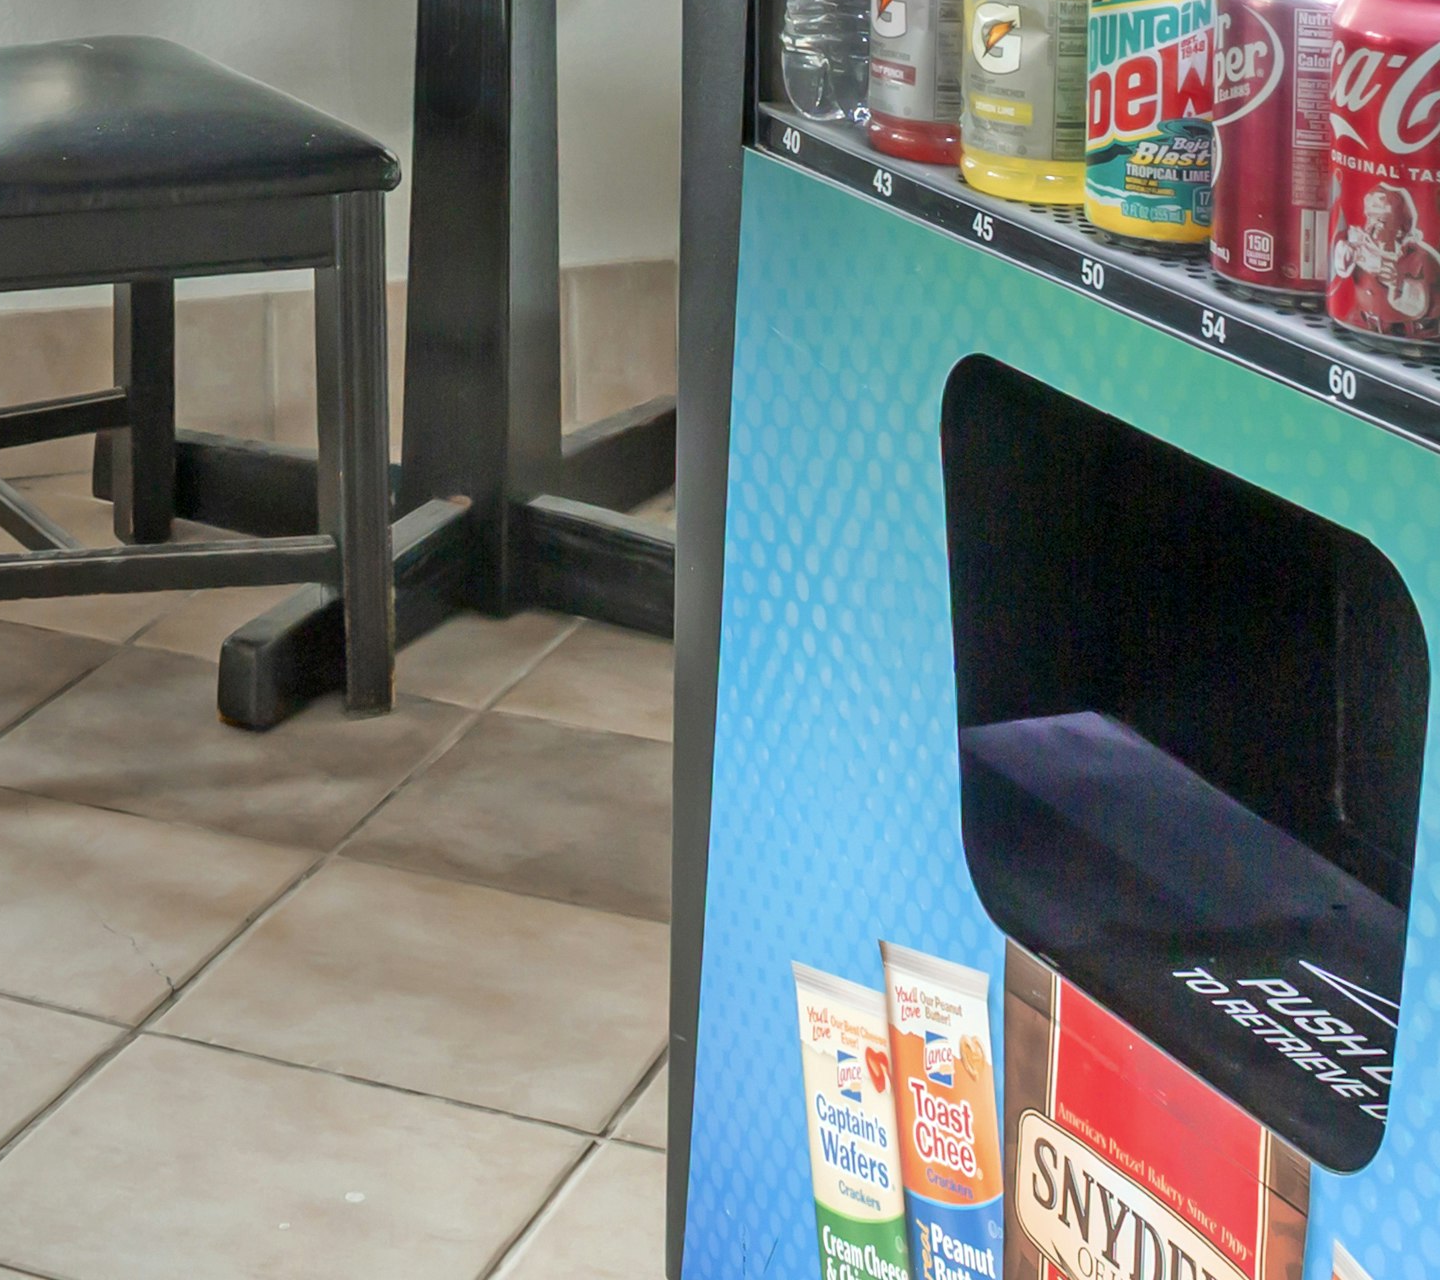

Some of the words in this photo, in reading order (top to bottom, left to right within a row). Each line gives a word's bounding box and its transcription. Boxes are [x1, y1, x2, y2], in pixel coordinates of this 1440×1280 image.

[782, 130, 801, 153] 40
[1130, 142, 1210, 166] Blast
[872, 172, 893, 197] 43
[1126, 164, 1178, 181] TROPICAL
[1183, 170, 1210, 182] LIME
[973, 213, 993, 240] 45
[1081, 258, 1104, 289] 50
[1202, 310, 1226, 343] 54
[1329, 366, 1356, 400] 60
[1173, 967, 1229, 994] TO
[1212, 999, 1378, 1098] RETRIEVE
[1237, 978, 1388, 1056] PUSH
[816, 1093, 887, 1148] Captain's
[910, 1082, 971, 1138] Toast
[819, 1127, 889, 1189] Wafers
[915, 1122, 974, 1173] Chee
[1058, 1102, 1106, 1151] America's
[1108, 1137, 1145, 1175] Pretzel
[1148, 1167, 1184, 1208] Bakery
[1187, 1198, 1218, 1234] Since
